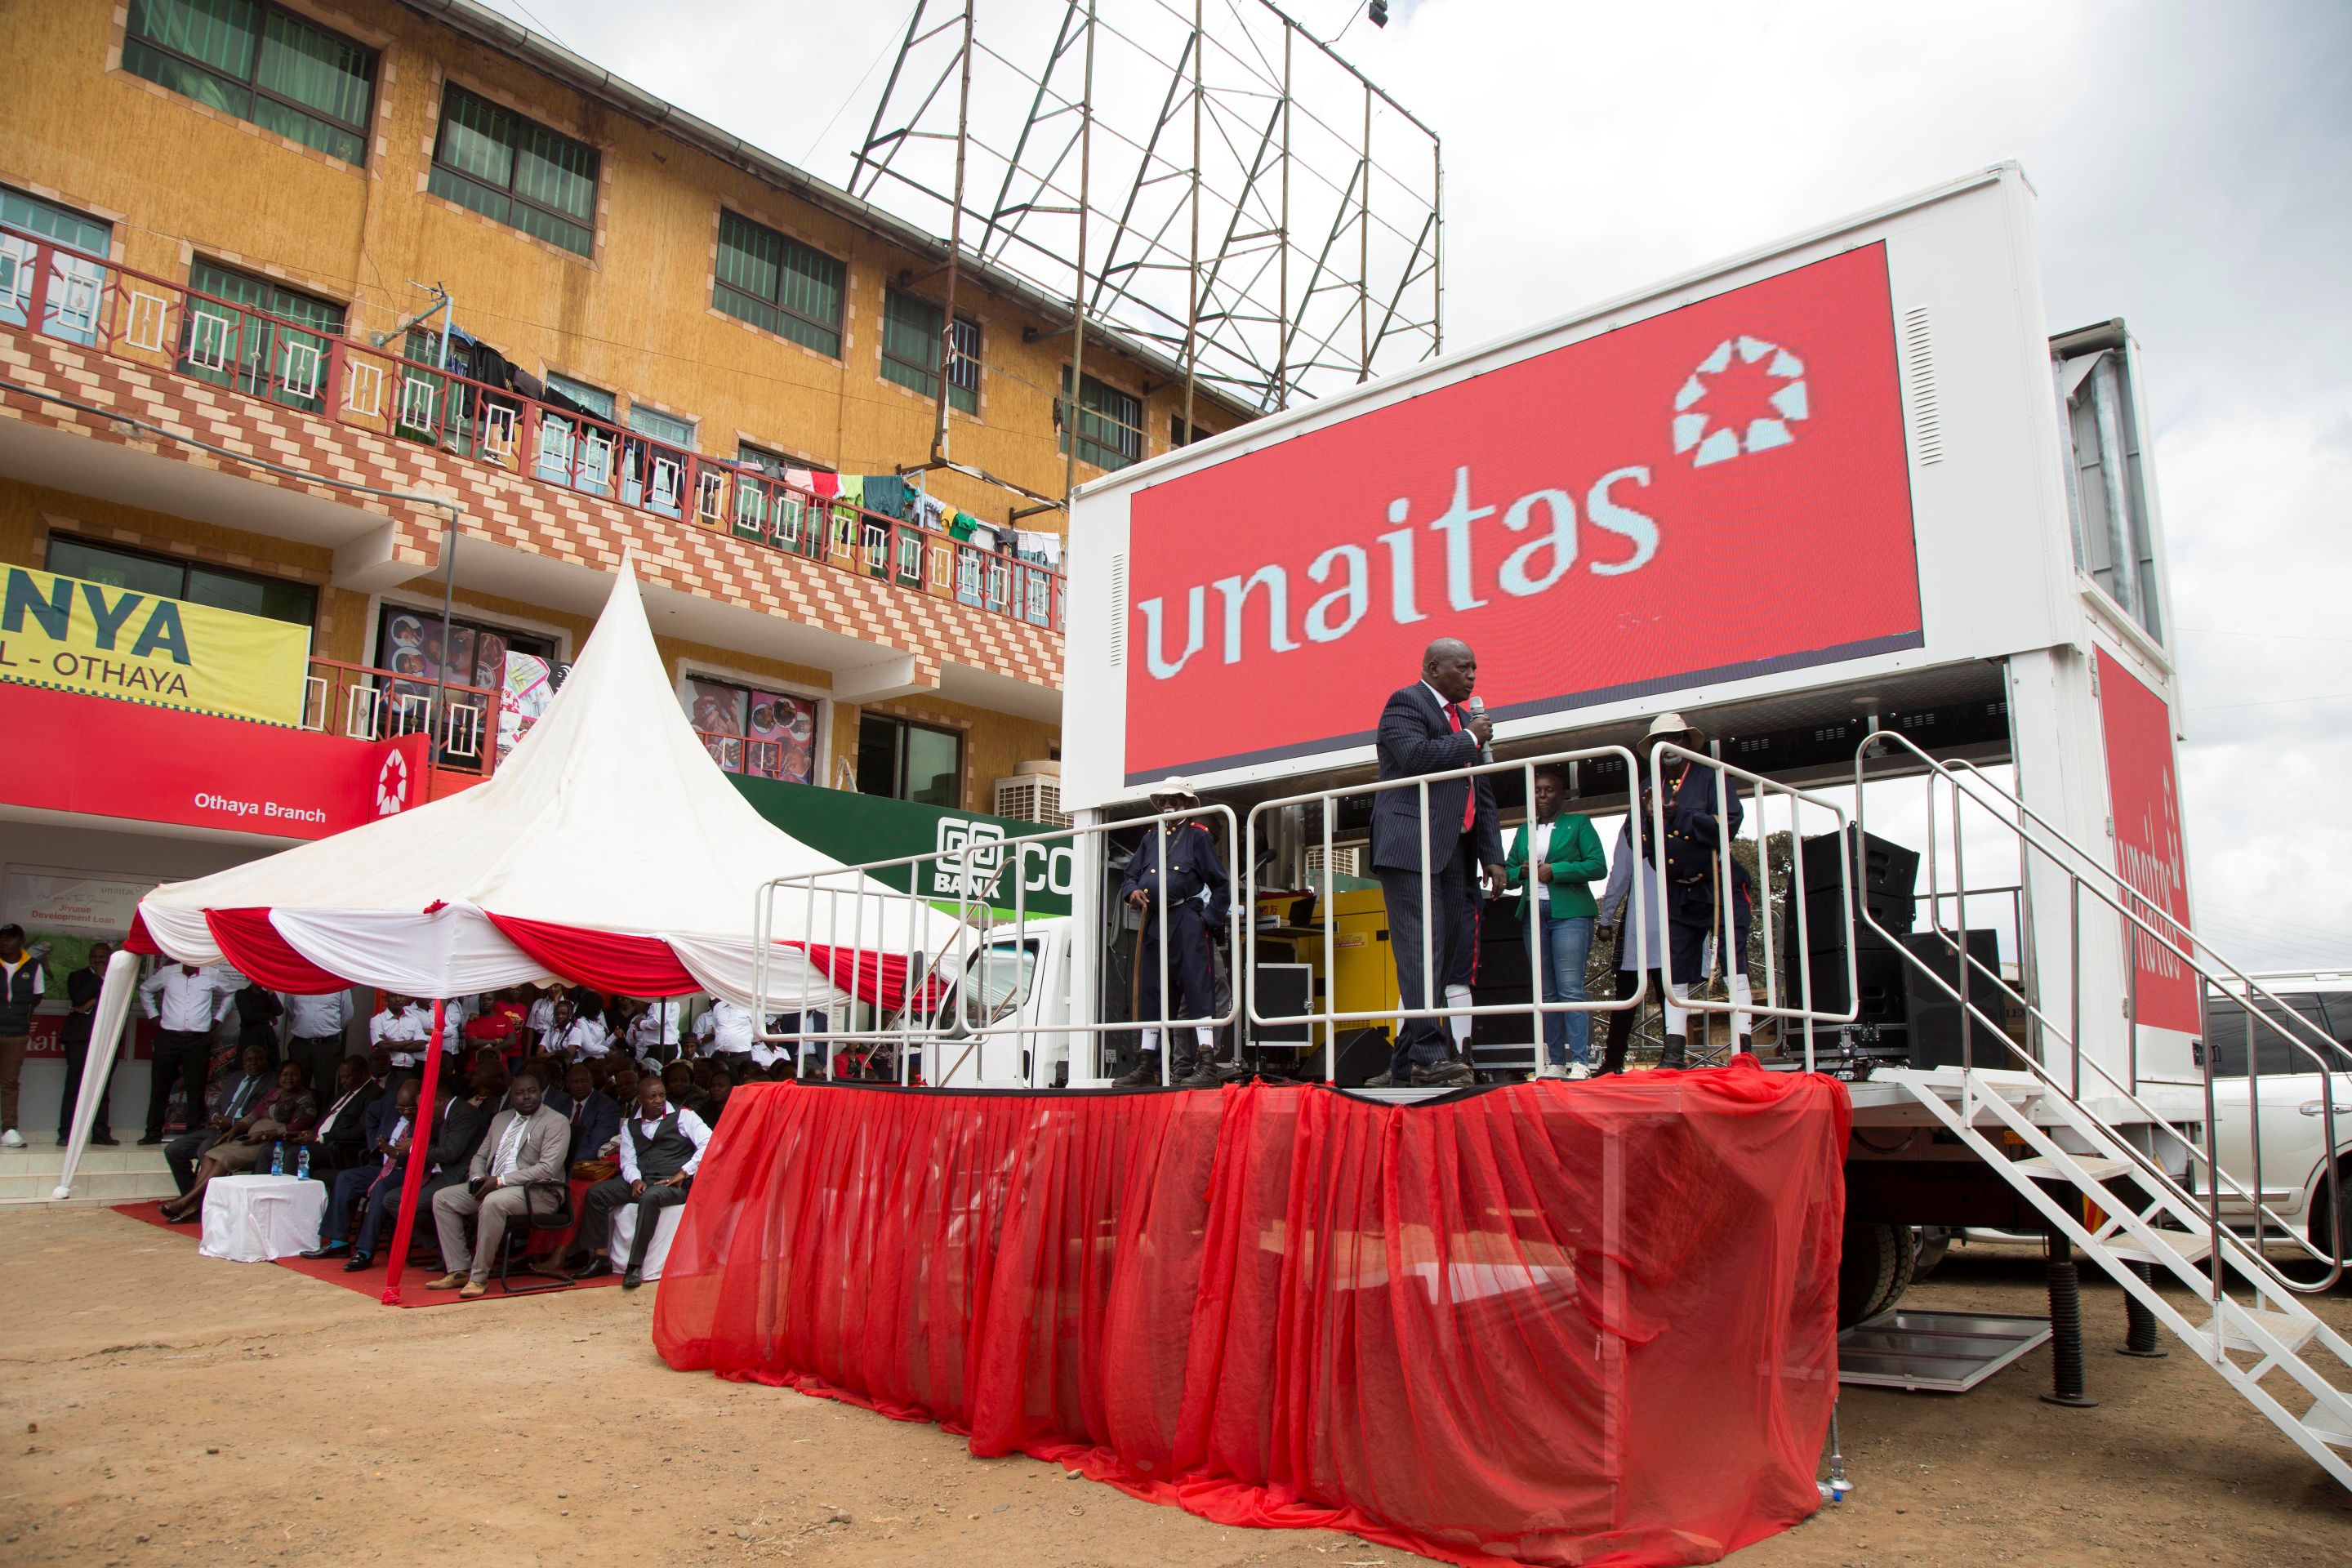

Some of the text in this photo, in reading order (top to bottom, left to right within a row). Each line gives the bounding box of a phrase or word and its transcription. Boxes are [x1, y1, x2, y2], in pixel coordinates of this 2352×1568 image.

[1138, 466, 1659, 680] unaitas
[2, 568, 192, 666] NYA
[53, 653, 188, 697] OTHAYA
[194, 792, 326, 823] Othaya Branch
[101, 886, 135, 896] unaitas
[934, 872, 1000, 899] BANK
[32, 911, 115, 924] Development Loan
